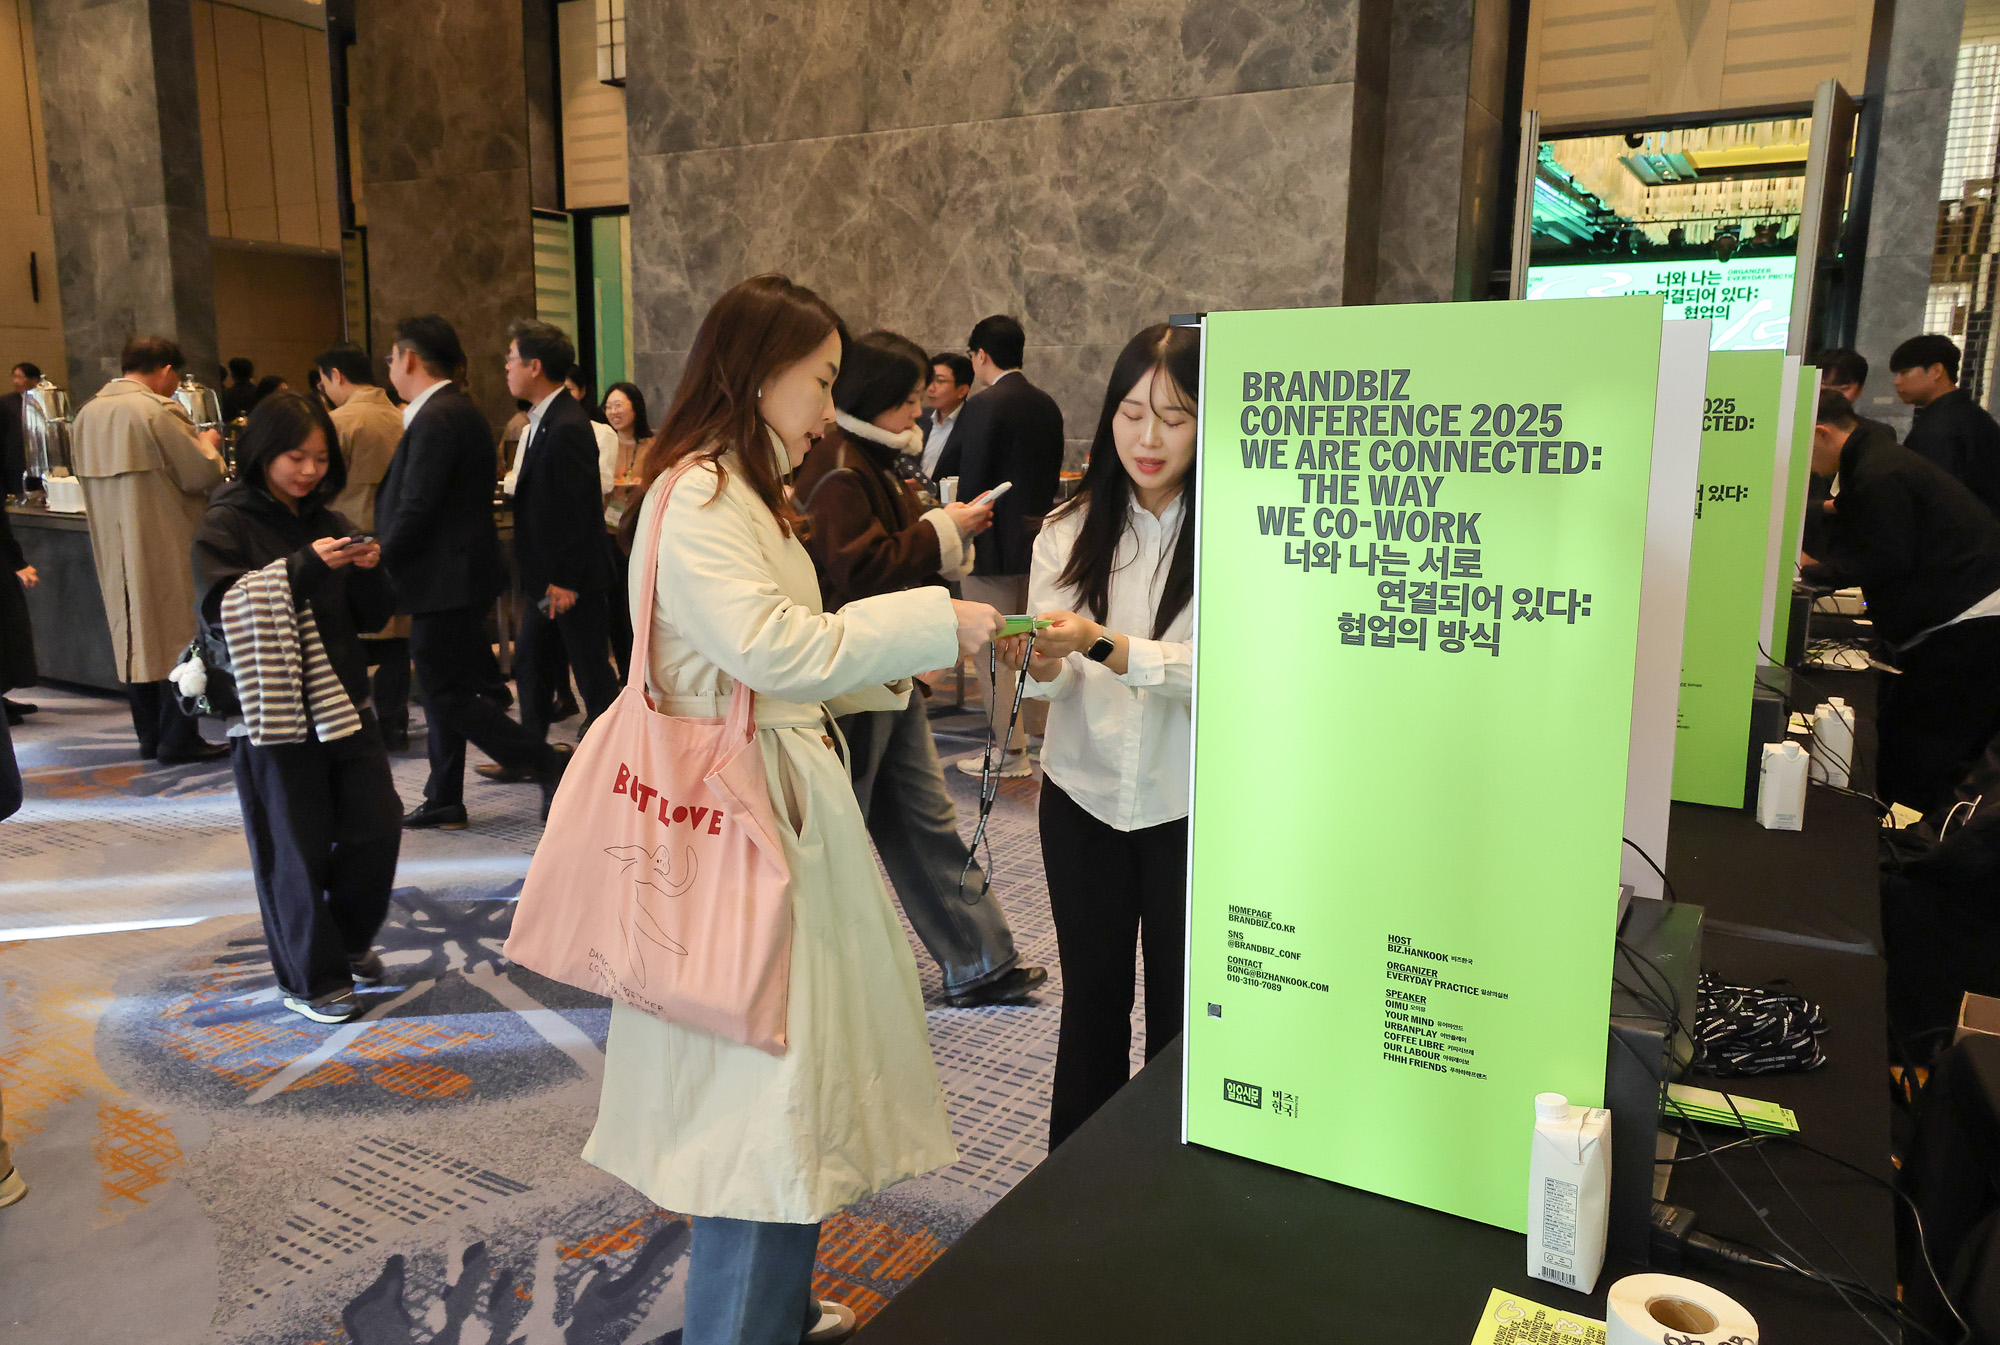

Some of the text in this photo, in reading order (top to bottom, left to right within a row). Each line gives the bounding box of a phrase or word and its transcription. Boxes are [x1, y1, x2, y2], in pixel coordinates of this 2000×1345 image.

[1657, 270, 1722, 287] 너와 나는
[1721, 286, 1759, 303] 있다:
[1242, 369, 1411, 402] BRANDBIZ
[1703, 398, 1736, 415] 025
[1240, 403, 1563, 437] CONFERENCE 2025
[1702, 415, 1755, 432] CTED:
[1240, 439, 1603, 475] WE ARE CONNECTED:
[1298, 473, 1445, 507] THE WAY
[1708, 484, 1749, 503] 있다:
[1257, 505, 1482, 545] WE CO-WORK
[1284, 540, 1483, 580] 너와 나는 서로
[1377, 579, 1592, 625] 연결되어 있다:
[1338, 612, 1501, 658] 협업의 방식
[658, 796, 724, 836] LOVE
[1228, 904, 1273, 920] HOMEPAGE
[1228, 913, 1296, 933] BRANDBIZ.CO.KR
[1228, 930, 1244, 940] SNS
[1387, 934, 1412, 946] HOST
[1227, 940, 1301, 960] @BRANDBIZ_CONF
[1387, 943, 1449, 963] BIZ.HANKOOK
[1227, 955, 1263, 969] CONTACT
[1386, 961, 1438, 978] ORGANIZER
[1226, 973, 1282, 992] 010-3110-7089
[1227, 964, 1329, 993] BONG@BIZHANKOOK.COM
[1386, 971, 1433, 987] EVERYDAY
[1434, 980, 1480, 996] PRACTICE
[1385, 988, 1427, 1004] SPEAKER
[1385, 999, 1409, 1011] OIMU
[1385, 1009, 1409, 1022] YOUR
[1410, 1015, 1435, 1027] MIND
[1384, 1020, 1438, 1039] URBANPLAY
[1383, 1041, 1403, 1053] OUR
[1404, 1046, 1441, 1061] LABOUR
[1384, 1031, 1417, 1046] COFFEE
[1419, 1038, 1445, 1051] LIBRE
[1383, 1052, 1408, 1065] FHHH
[1409, 1057, 1448, 1073] FRIENDS
[1226, 1082, 1259, 1107] 일요신문
[1493, 1324, 1509, 1345] ANDBIZ
[1504, 1320, 1521, 1345] FERENCE
[1549, 1331, 1562, 1345] WORK
